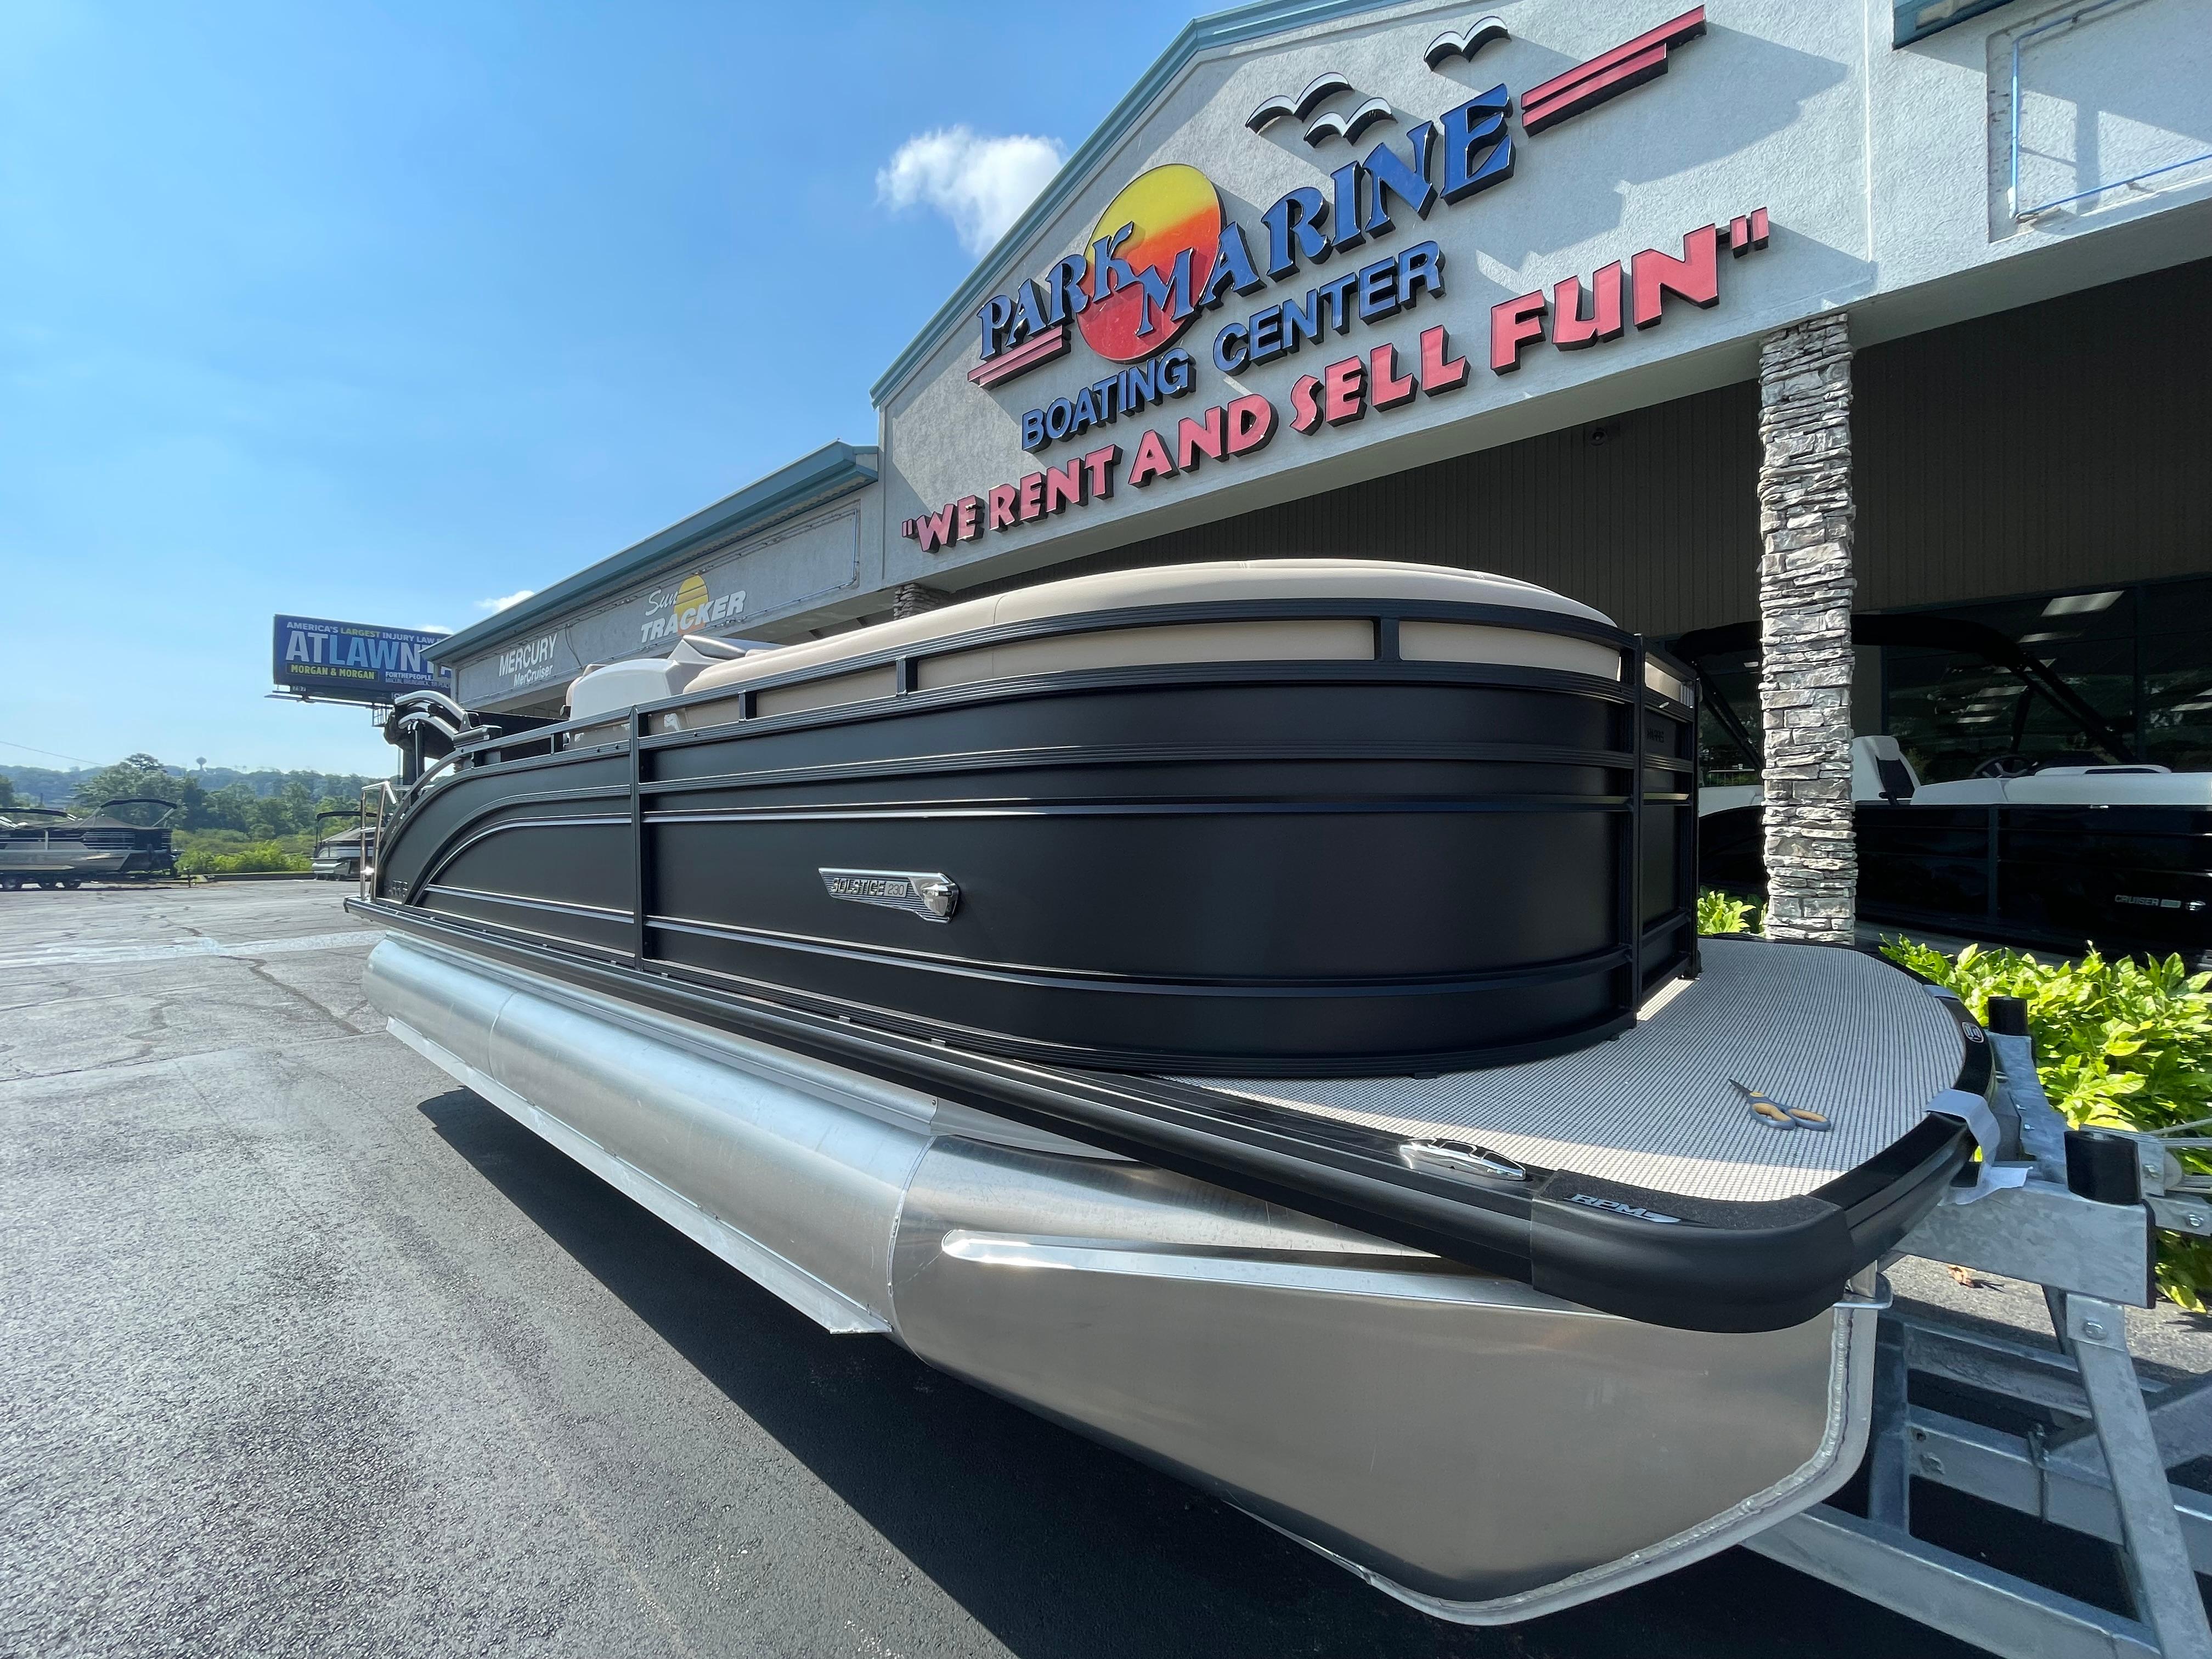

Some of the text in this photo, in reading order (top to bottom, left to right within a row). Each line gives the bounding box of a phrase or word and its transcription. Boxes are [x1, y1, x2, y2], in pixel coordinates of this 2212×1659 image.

[977, 82, 1516, 362] PARK MARINE
[1022, 240, 1446, 453] BOATING CENTER
[901, 206, 1770, 553] "WE RENT AND SELL FUN"
[287, 621, 338, 634] AMERICA'S
[340, 627, 380, 639] LARGEST
[382, 631, 415, 642] INJURY
[416, 636, 435, 644] LAW
[641, 590, 747, 643] TRACKER
[291, 664, 375, 680] MORGAN & MORGAN
[499, 633, 558, 677] MERCURY
[514, 663, 554, 687] MerCruiser
[832, 878, 904, 896] SOLSTICE 230
[2115, 895, 2159, 906] CRUISER
